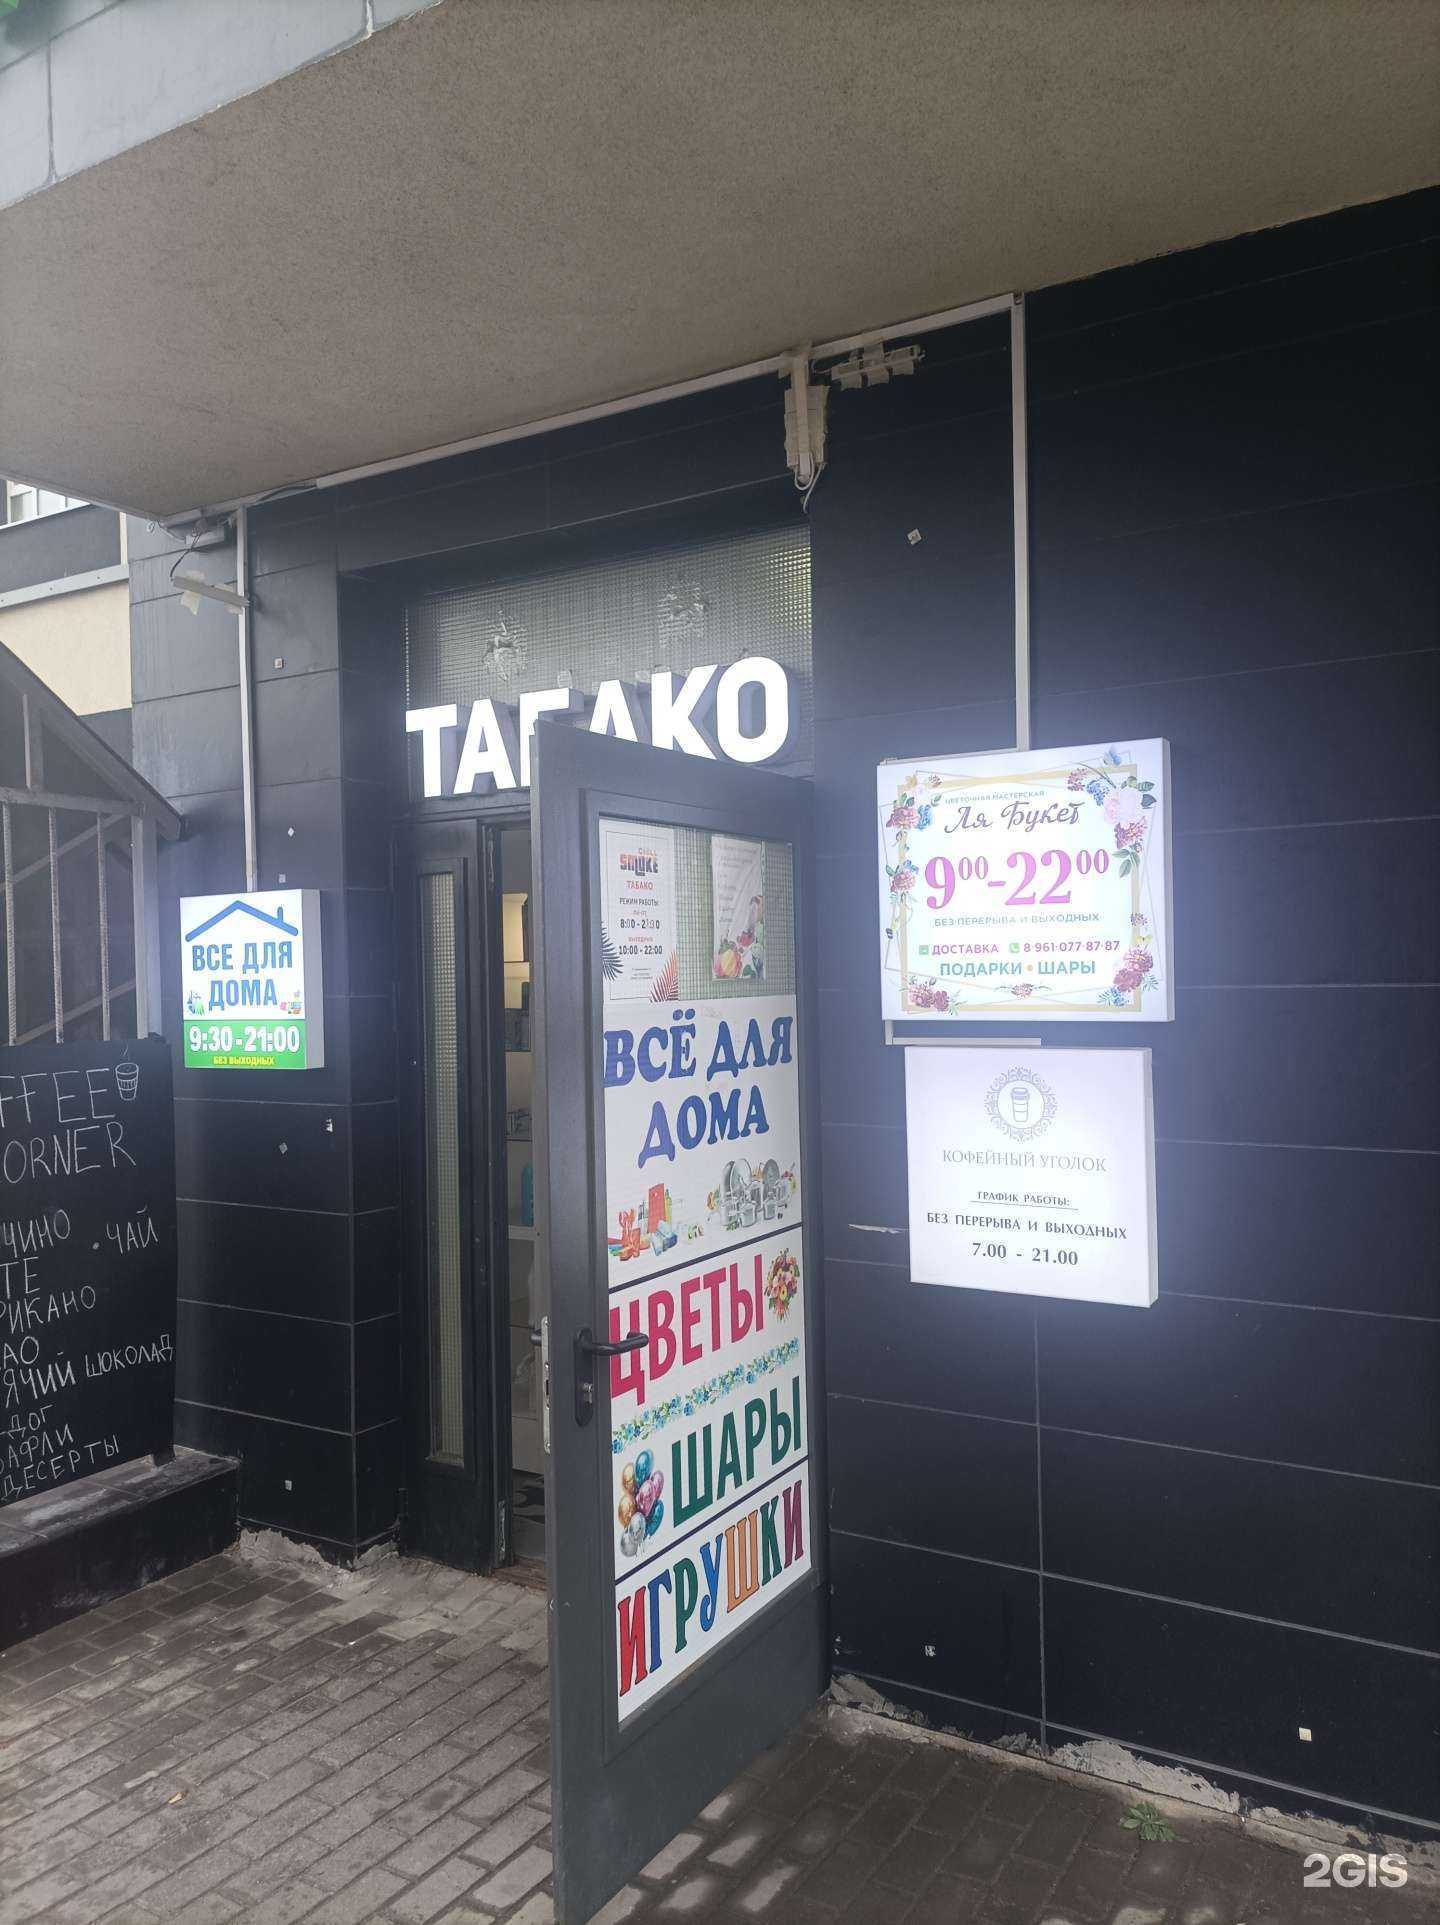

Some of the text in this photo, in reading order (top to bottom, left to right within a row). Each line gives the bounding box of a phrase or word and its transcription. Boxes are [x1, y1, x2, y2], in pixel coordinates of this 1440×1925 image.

[944, 800, 1085, 833] Ля Букет
[934, 918, 954, 927] БЕЗ
[957, 915, 1017, 926] ПЕРЕРЫВА
[1031, 912, 1100, 925] ВЫХОДНЫХ
[192, 941, 293, 974] ВСЕ ДЛЯ
[618, 945, 639, 955] 10:00
[644, 945, 663, 955] 22:00
[932, 944, 999, 956] ДОСТАВКА
[940, 961, 1096, 978] ПОДАРКИ ШАРЫ
[208, 979, 278, 1011] ДОМА
[604, 1008, 794, 1089] ВСЁ ДЛЯ
[638, 1085, 770, 1169] ДОМА
[943, 1148, 1108, 1172] КОФЕЙНЫЙ УГОЛОК
[977, 1190, 1071, 1207] ГРАФИК РАБОТЫ:
[106, 1205, 158, 1254] ЧАЙ
[927, 1212, 1127, 1240] БЕЗ ПЕРЕРЫВА И ВЫХОДНЫХ
[972, 1242, 1007, 1259] 7.00
[1031, 1247, 1079, 1266] 21.00
[609, 1254, 765, 1406] ЦВЕТЫ
[85, 1334, 174, 1378] ШОКОЛАД
[672, 1376, 801, 1528] ШАРЫ
[617, 1480, 804, 1697] ИГРУШКИ
